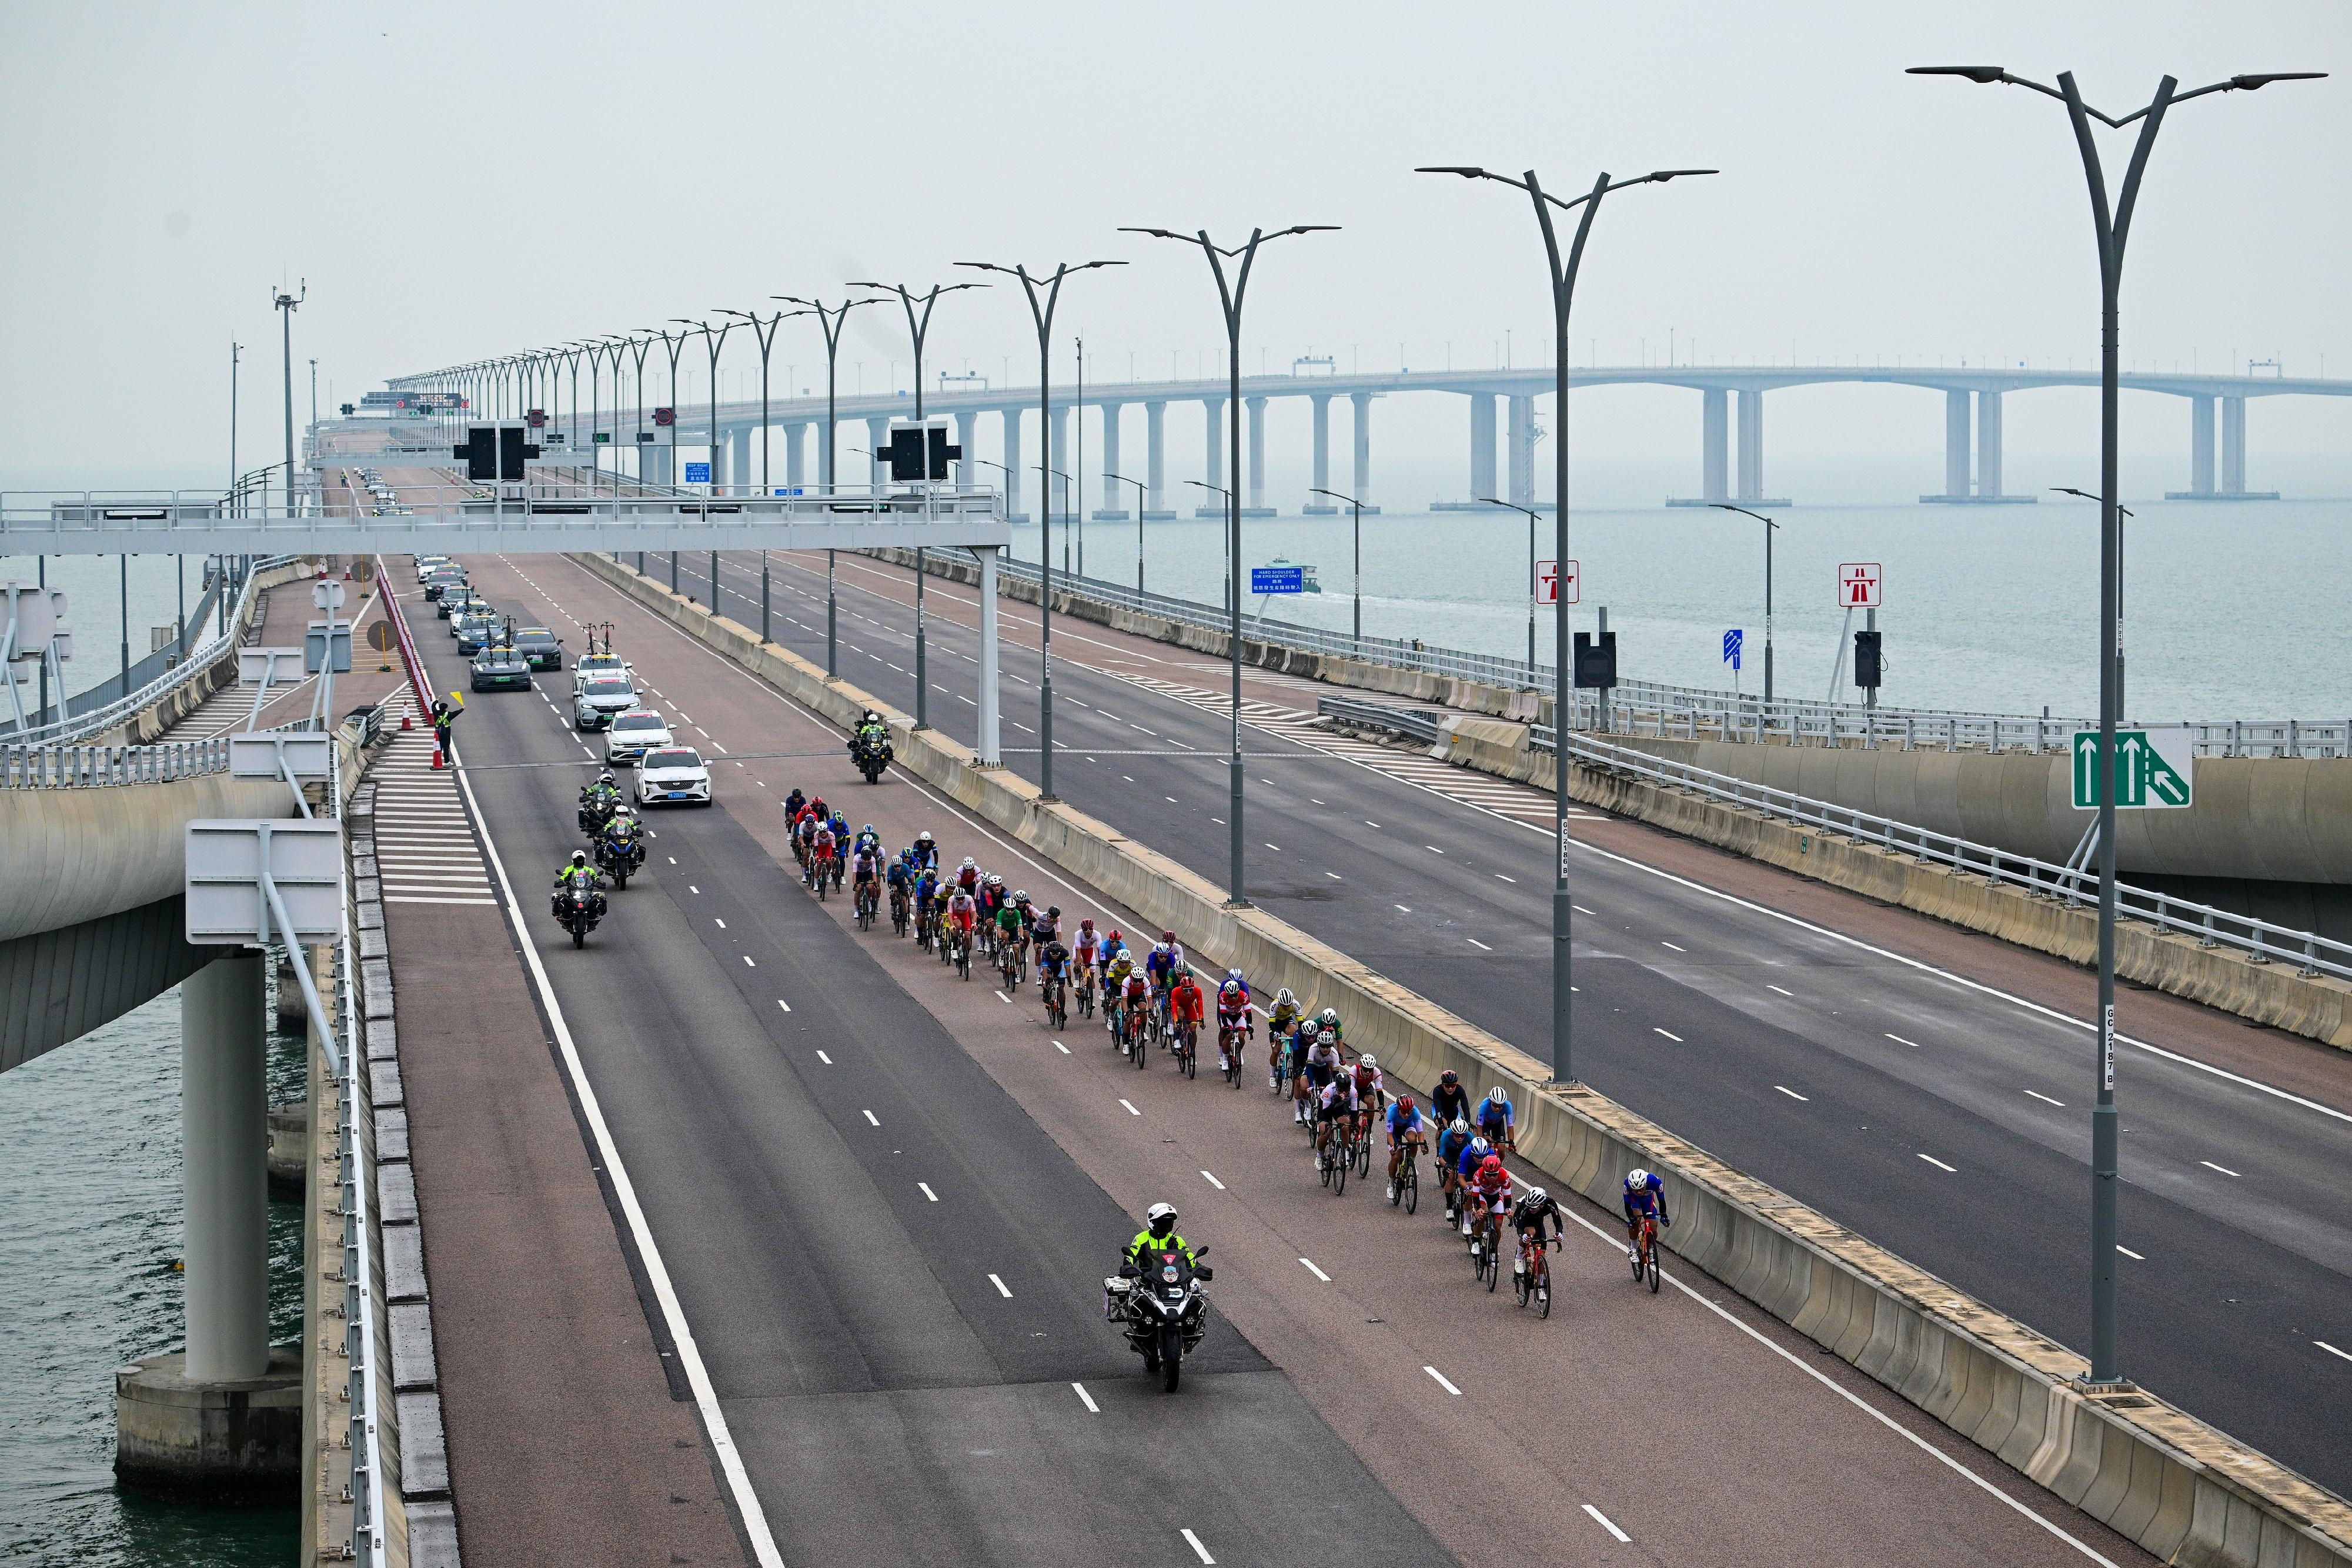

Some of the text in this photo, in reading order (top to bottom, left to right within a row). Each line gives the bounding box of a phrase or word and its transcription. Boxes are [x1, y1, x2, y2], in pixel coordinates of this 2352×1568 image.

[2119, 620, 2122, 628] GC
[1046, 644, 1050, 653] GC
[1237, 710, 1241, 720] GC
[1563, 822, 1568, 835] GC
[2107, 1009, 2113, 1027] GC
[2107, 1075, 2113, 1083] B
